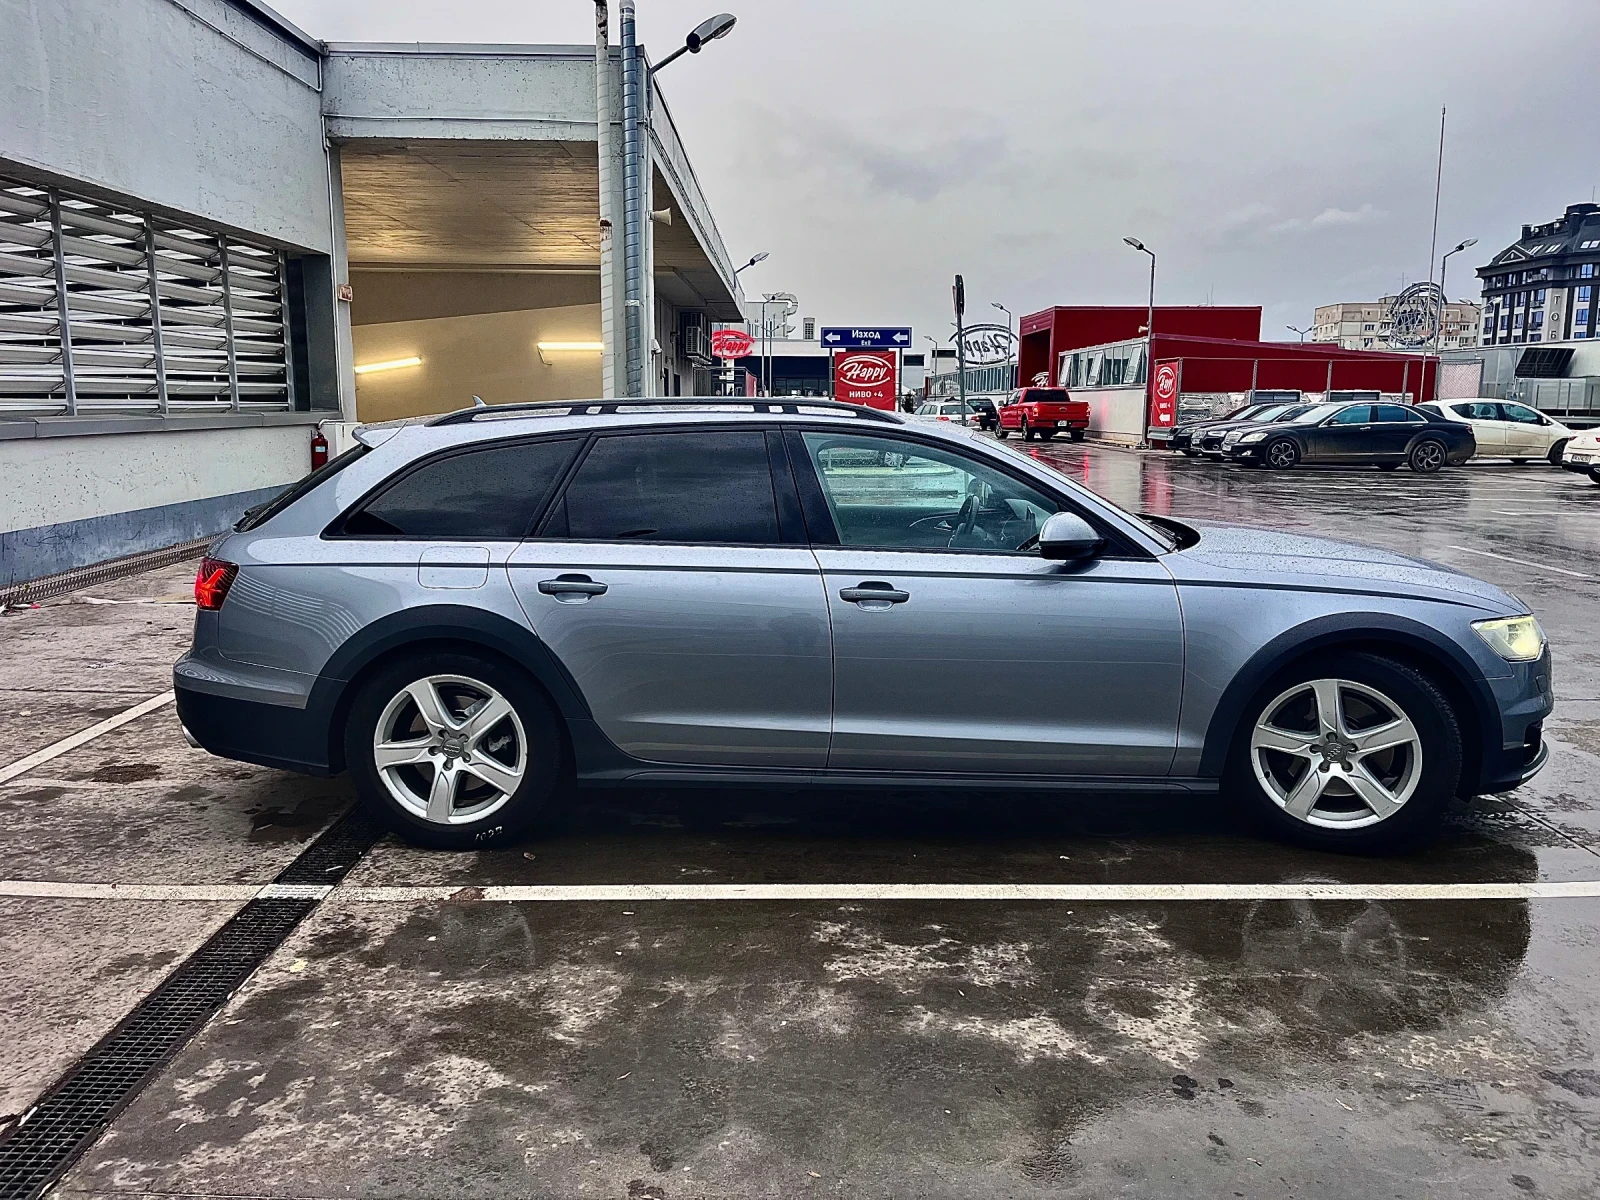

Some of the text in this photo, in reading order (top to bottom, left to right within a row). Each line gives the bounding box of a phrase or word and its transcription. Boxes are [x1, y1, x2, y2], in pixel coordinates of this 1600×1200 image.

[851, 329, 881, 340] Изход
[843, 362, 887, 381] Happy
[849, 390, 884, 398] НИВО +4
